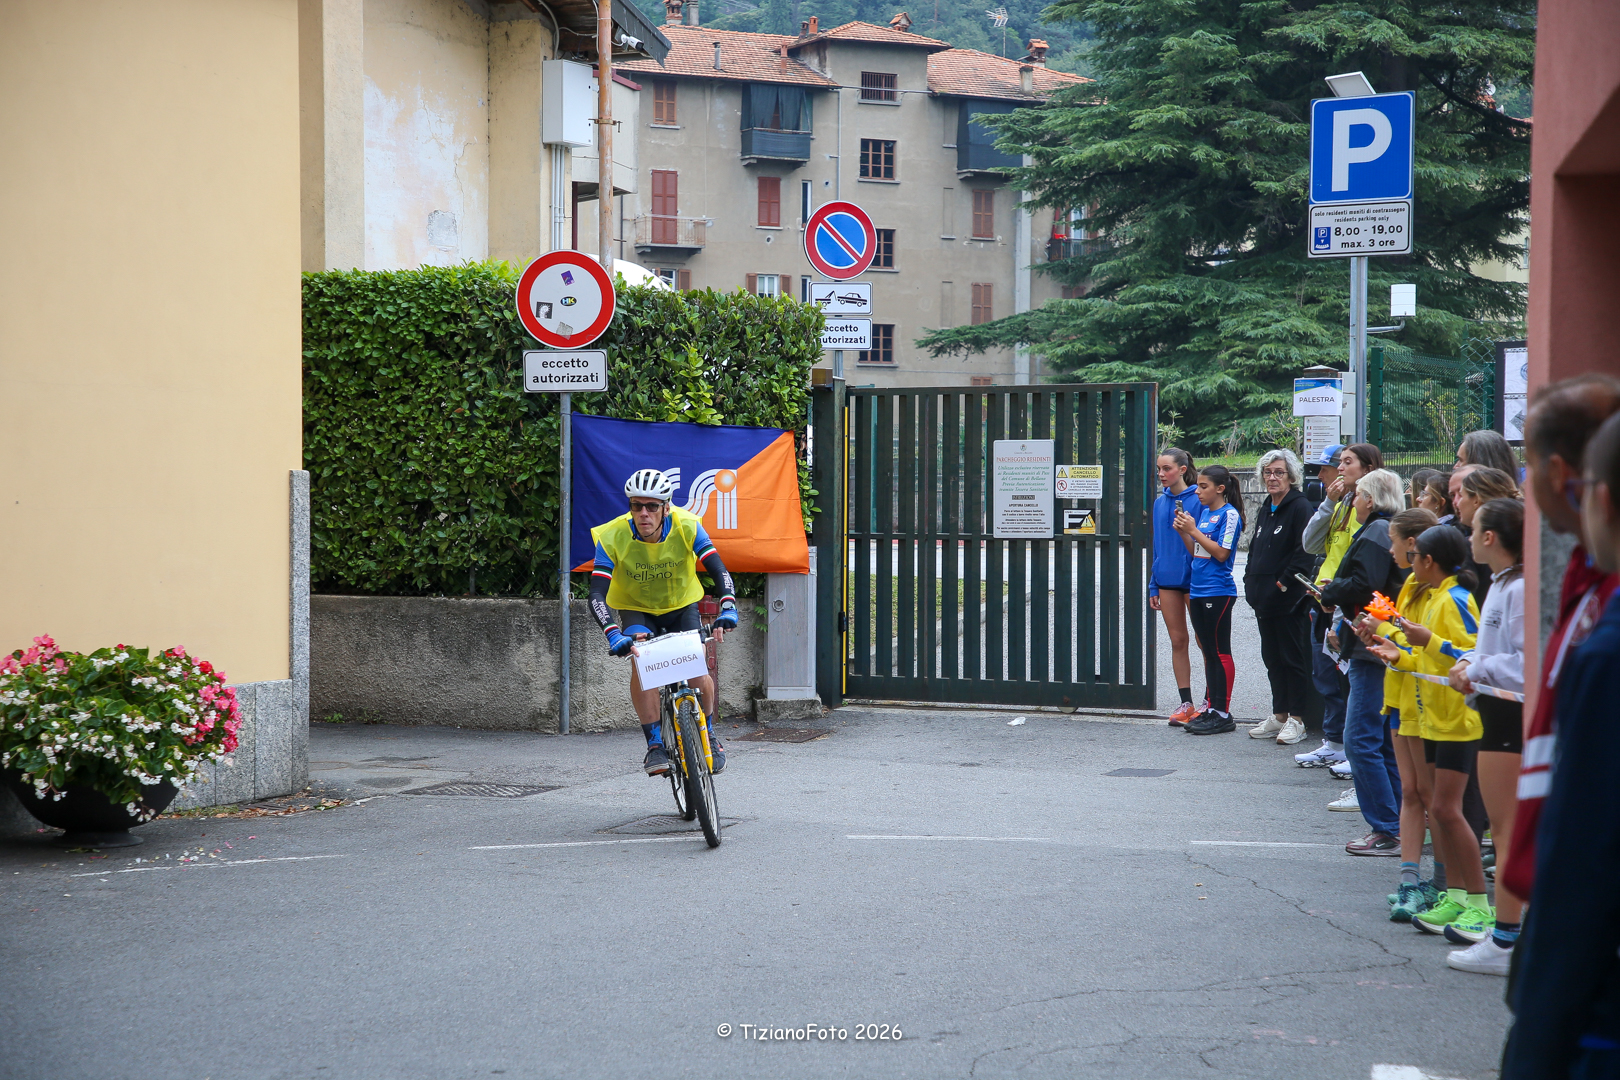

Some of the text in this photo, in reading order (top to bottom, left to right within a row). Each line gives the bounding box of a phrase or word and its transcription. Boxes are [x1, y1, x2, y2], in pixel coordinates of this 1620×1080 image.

[1331, 108, 1393, 192] P
[1368, 239, 1375, 247] 3
[542, 358, 589, 368] eccetto
[532, 372, 599, 383] autorizzati
[645, 653, 698, 672] INIZIO CORSA
